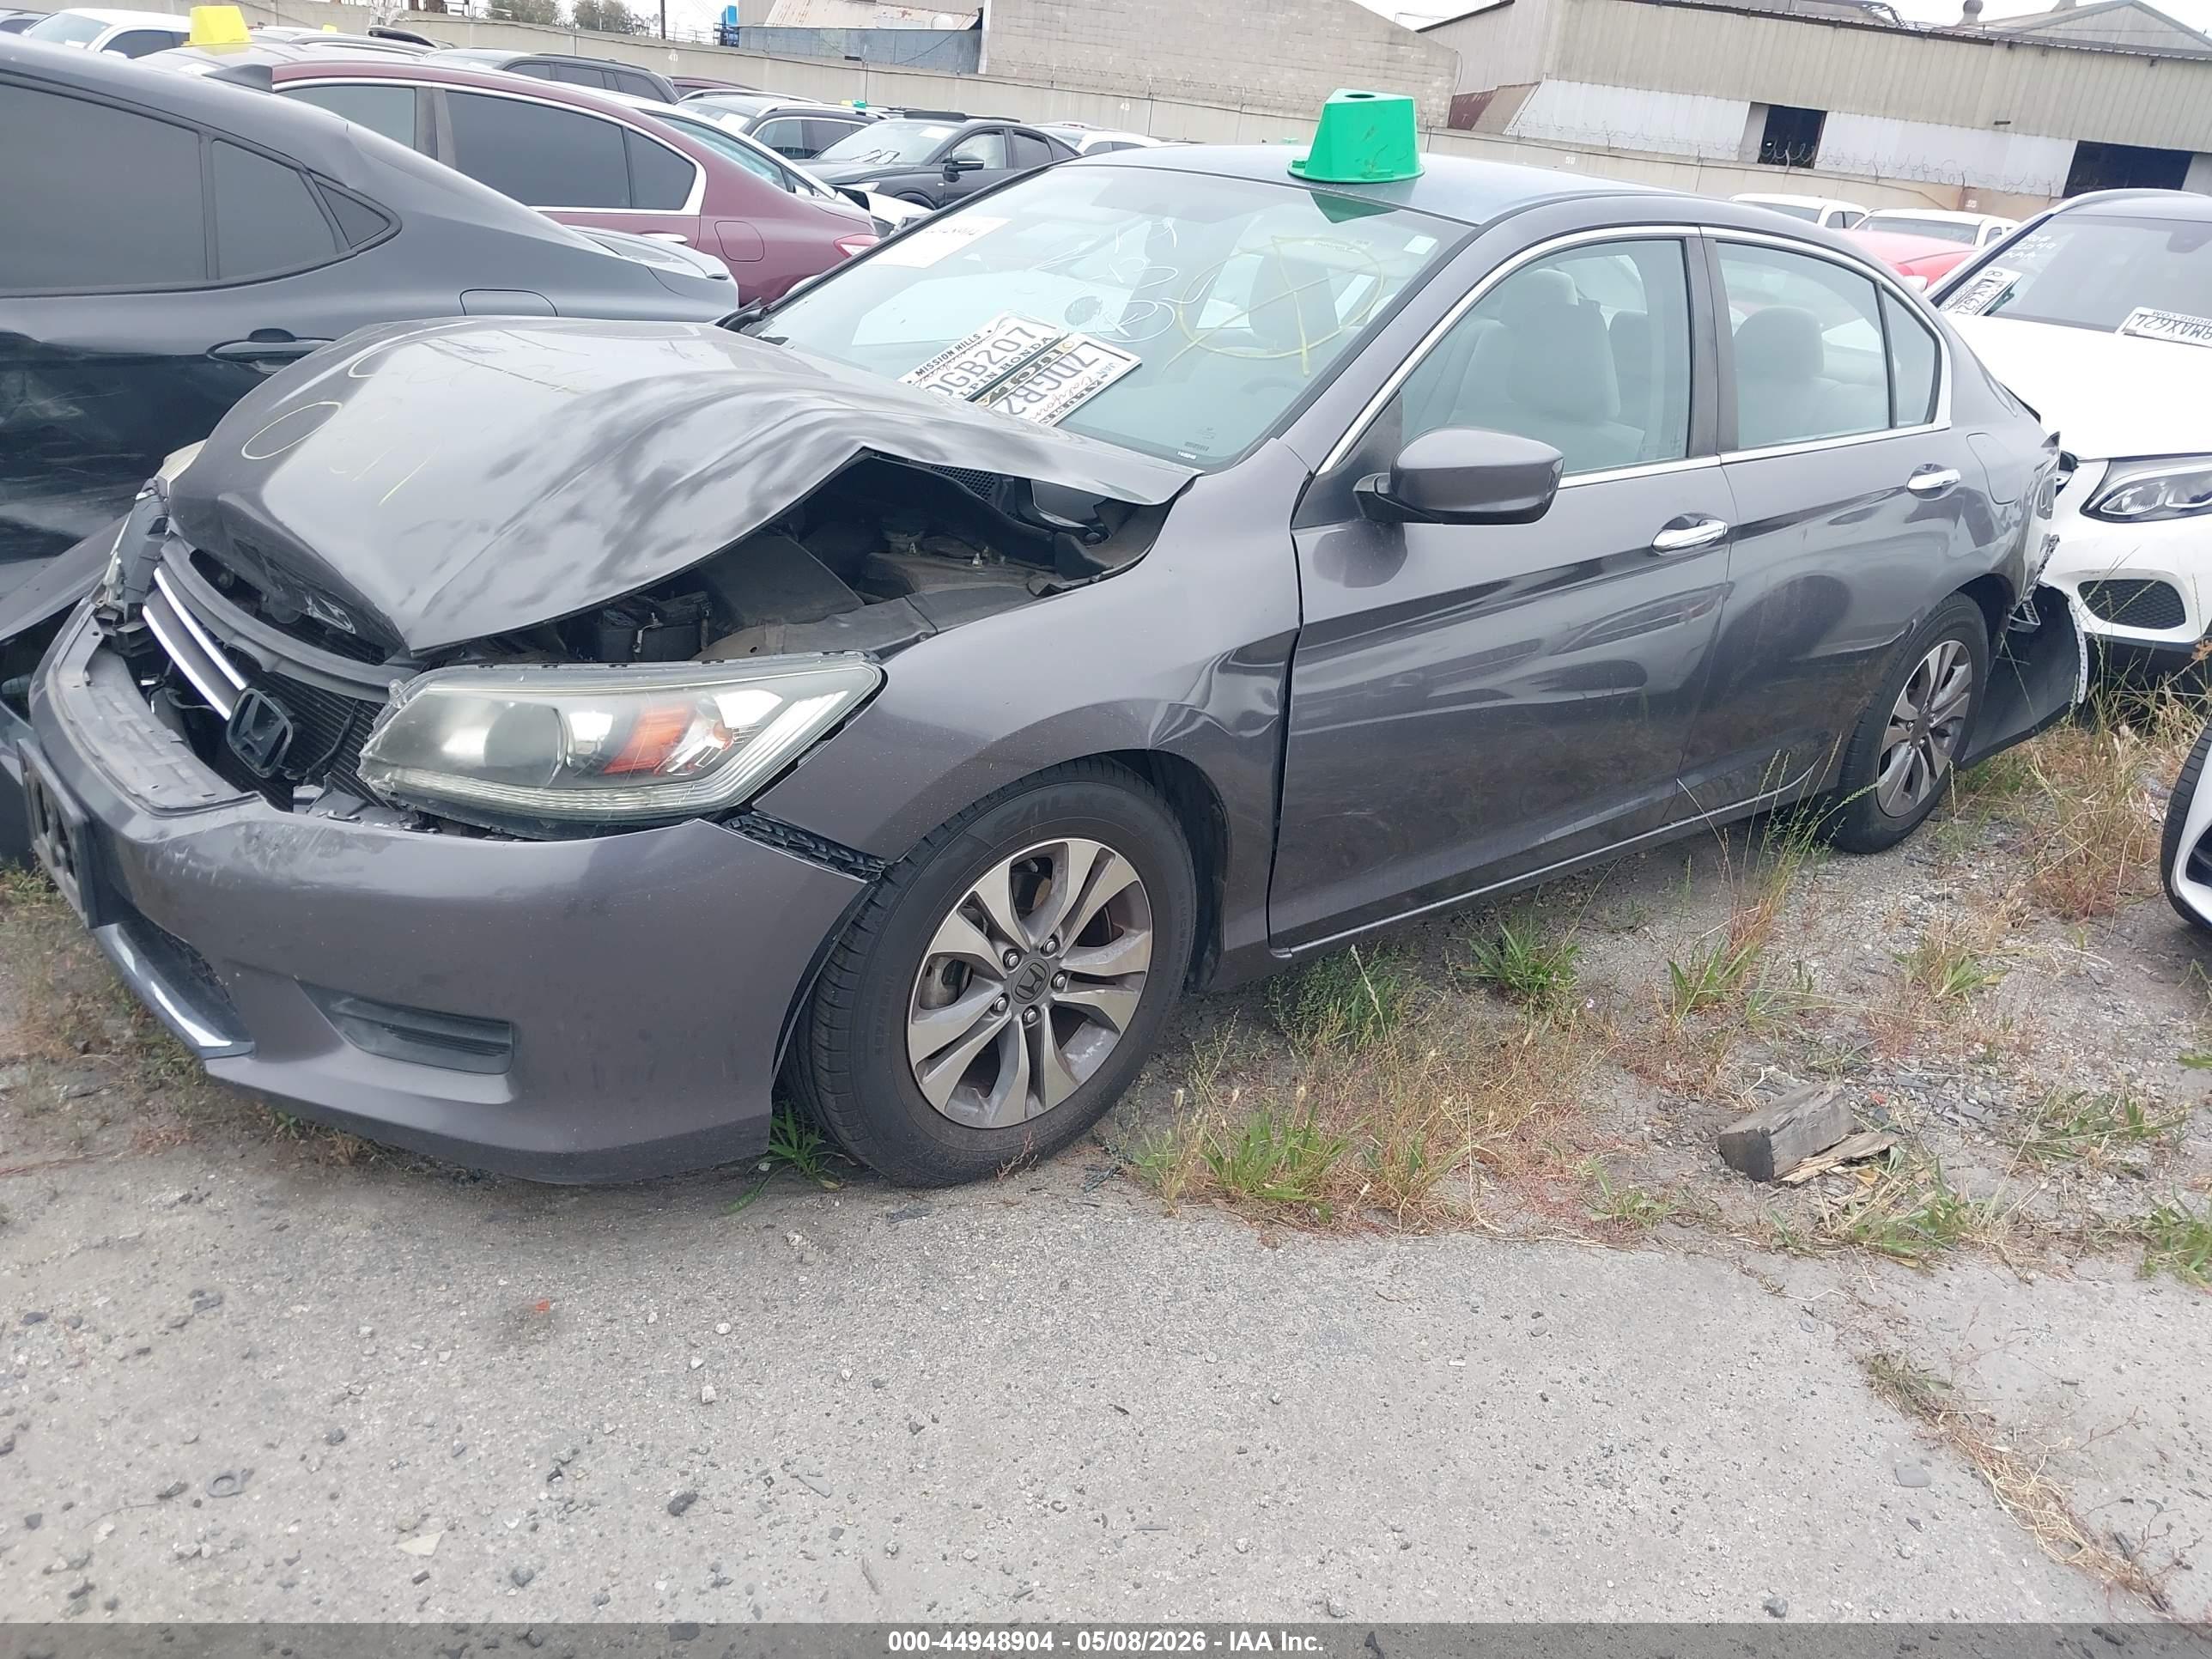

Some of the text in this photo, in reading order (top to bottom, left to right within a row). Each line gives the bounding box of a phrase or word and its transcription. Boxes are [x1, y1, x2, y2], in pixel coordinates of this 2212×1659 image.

[915, 349, 956, 377] MISSION
[955, 333, 981, 352] HILLS
[999, 336, 1054, 372] HONDA
